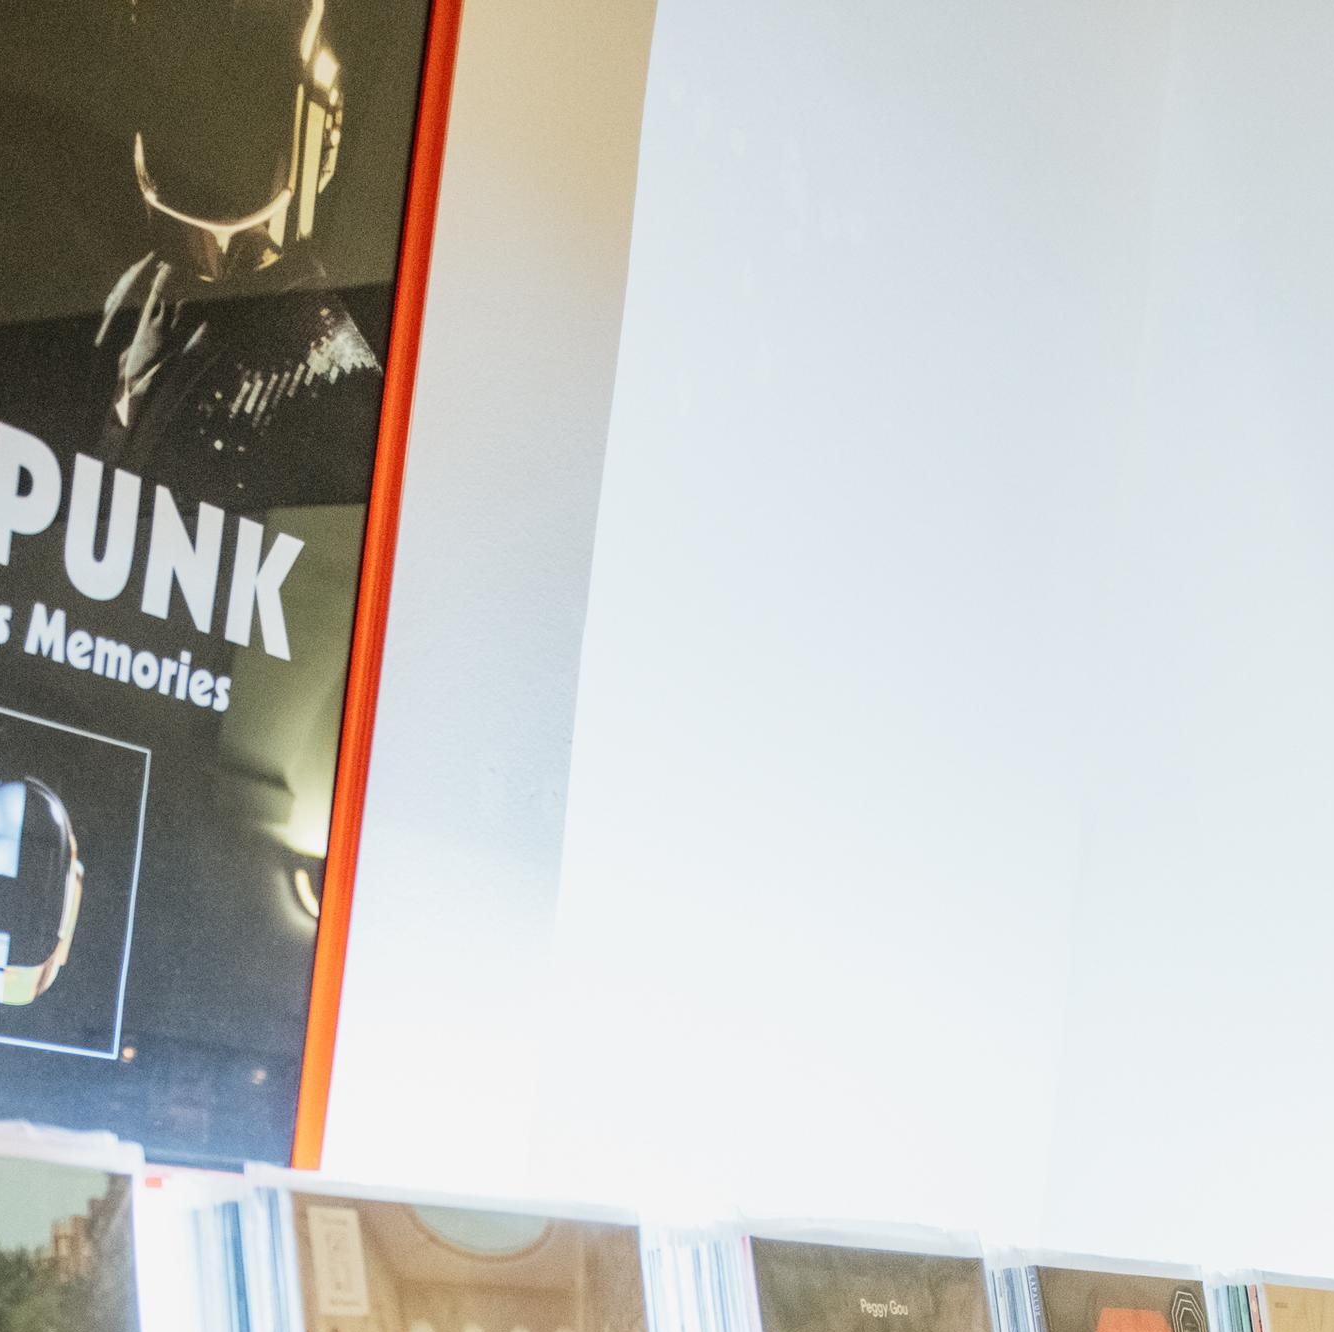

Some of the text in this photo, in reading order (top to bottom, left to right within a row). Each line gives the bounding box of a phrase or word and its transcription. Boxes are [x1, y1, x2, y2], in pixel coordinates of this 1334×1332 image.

[24, 602, 233, 713] Memories
[860, 1298, 909, 1318] Peggy Gou
